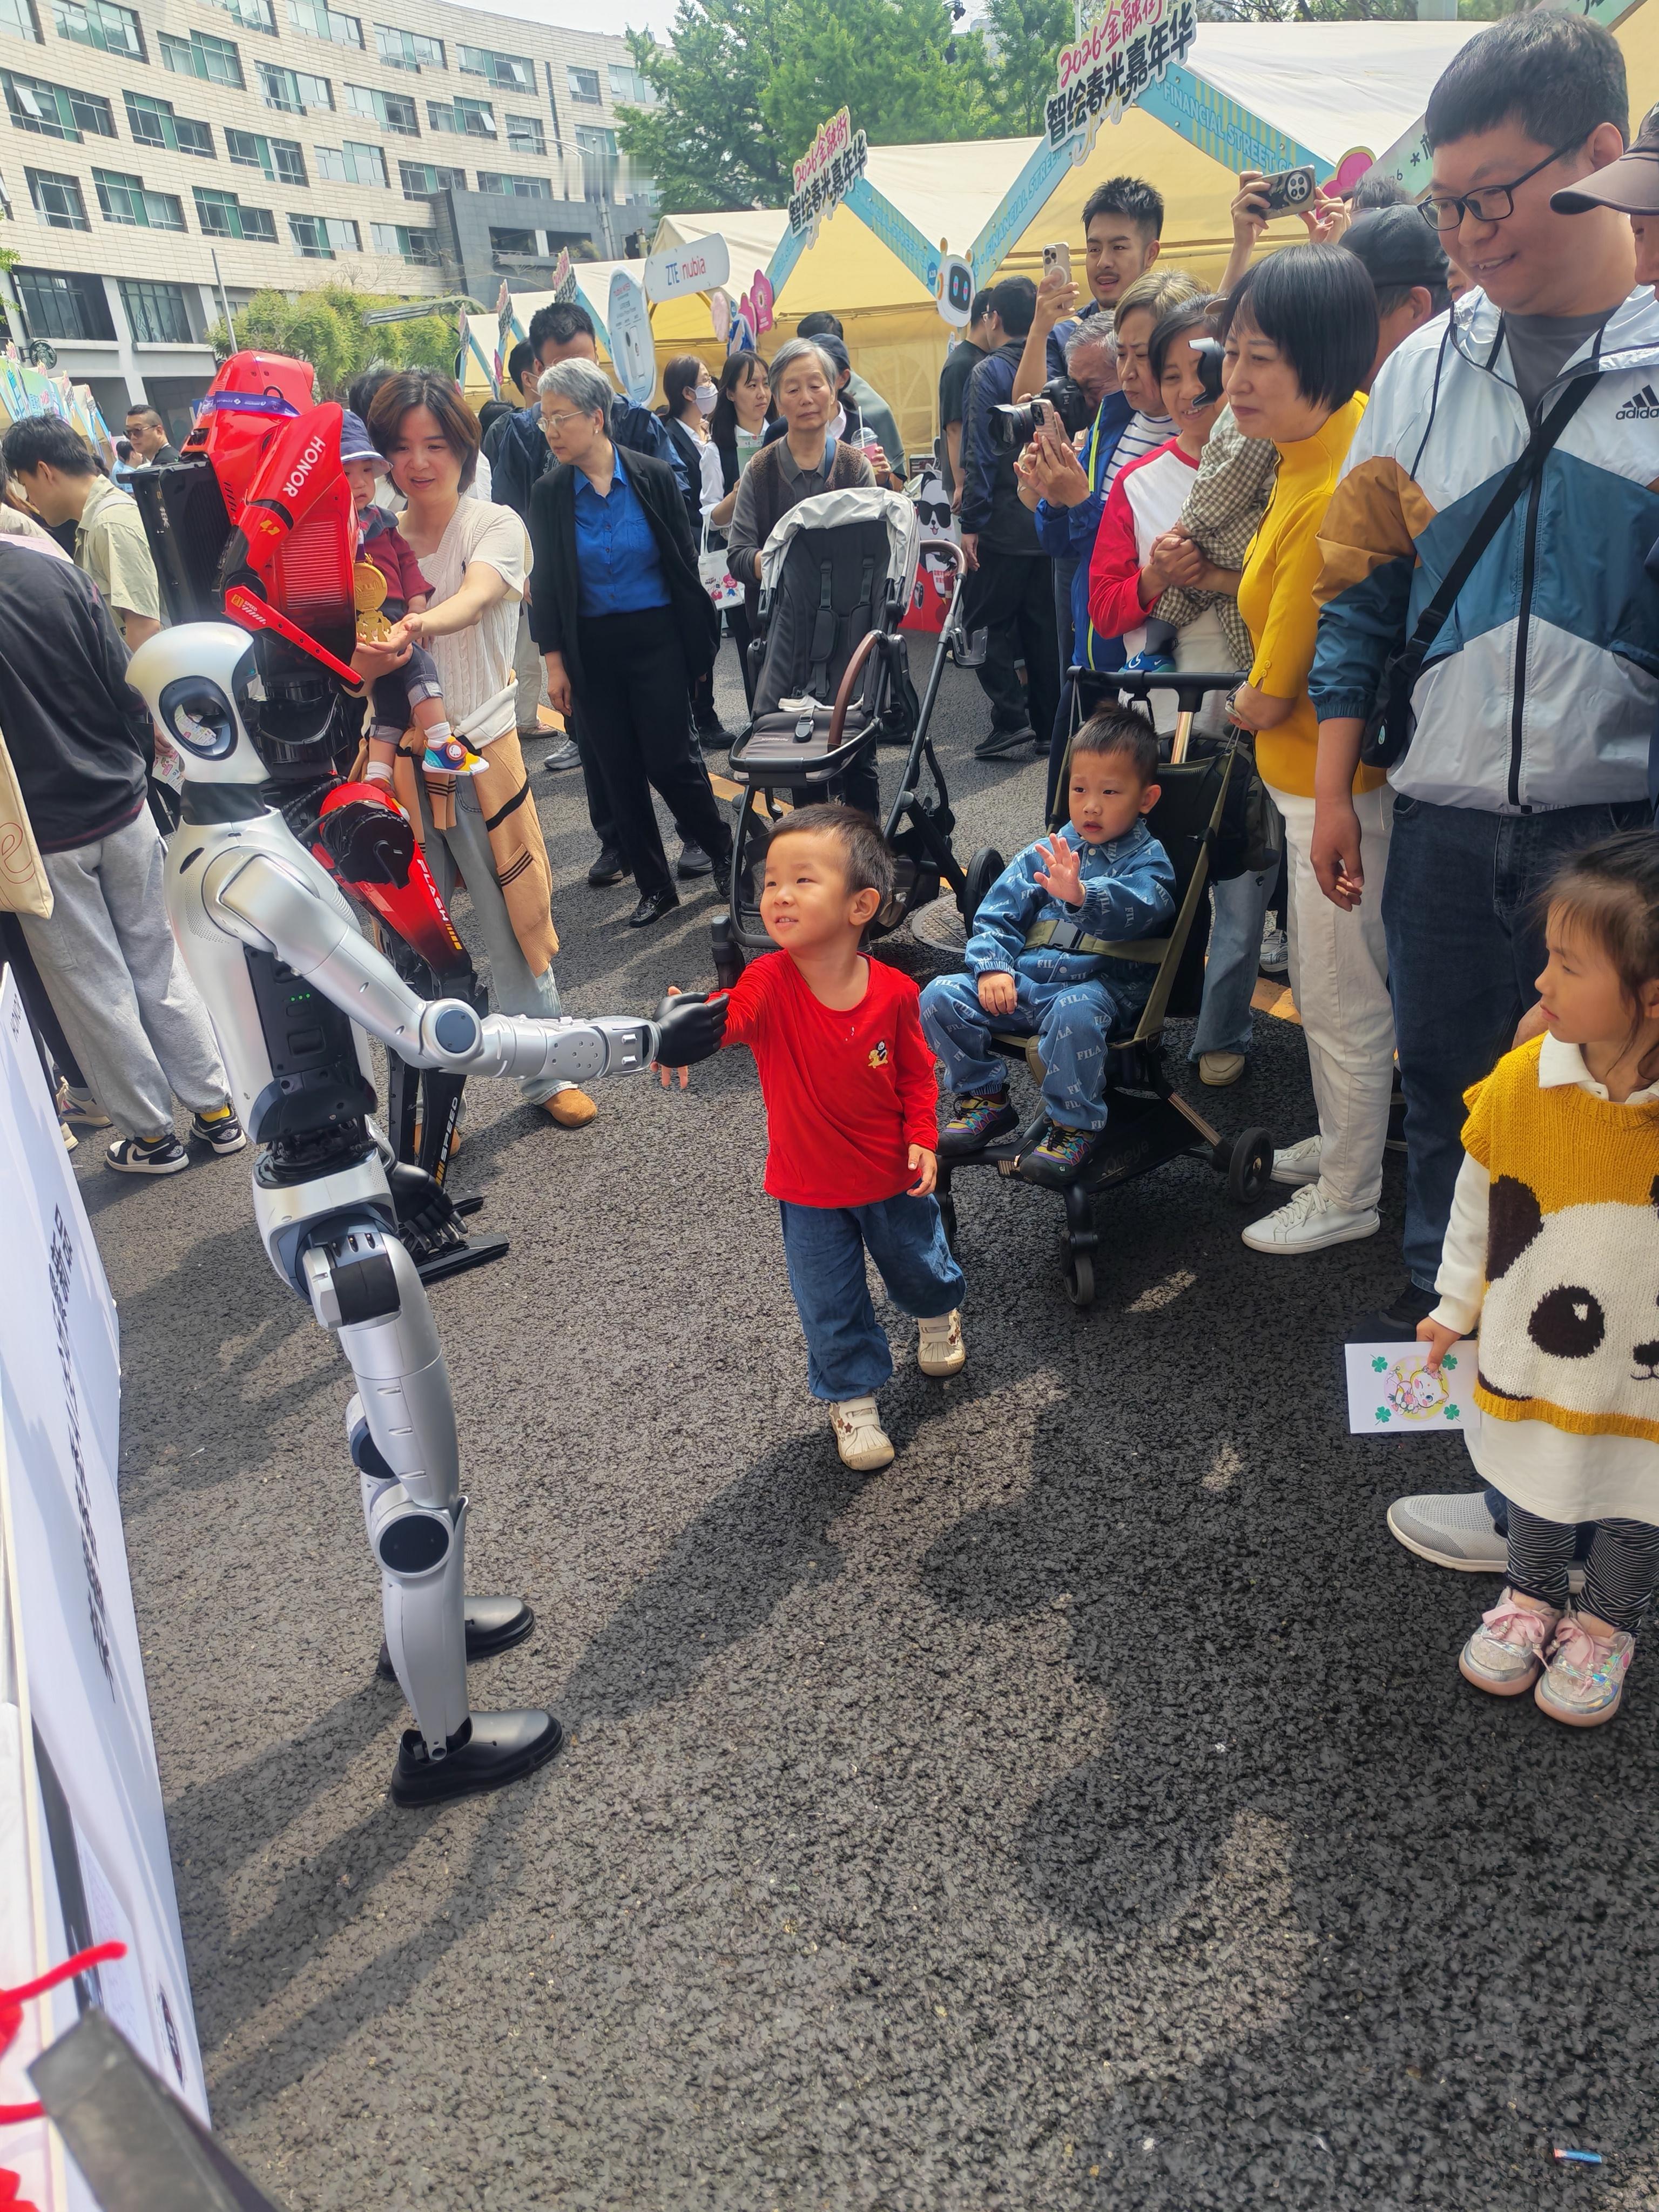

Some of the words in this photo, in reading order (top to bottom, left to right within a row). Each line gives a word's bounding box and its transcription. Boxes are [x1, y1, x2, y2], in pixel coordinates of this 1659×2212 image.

[1047, 2, 1193, 146] 智绘春光嘉年华
[1164, 82, 1225, 139] FINANCIAL
[1227, 123, 1276, 173] STREET
[795, 113, 848, 192] 2026金融街
[790, 134, 866, 234] 智绘春光嘉年华
[665, 262, 680, 286] ZTE
[682, 256, 706, 280] nubia
[1616, 407, 1659, 420] adida
[282, 436, 326, 497] HONOR
[416, 859, 449, 921] FLASH
[935, 979, 960, 991] FILA
[1037, 959, 1054, 968] FIL
[1058, 993, 1090, 1008] FILA
[946, 1023, 968, 1033] FILA
[1076, 1045, 1102, 1061] FILA
[441, 1097, 458, 1162] SPEED
